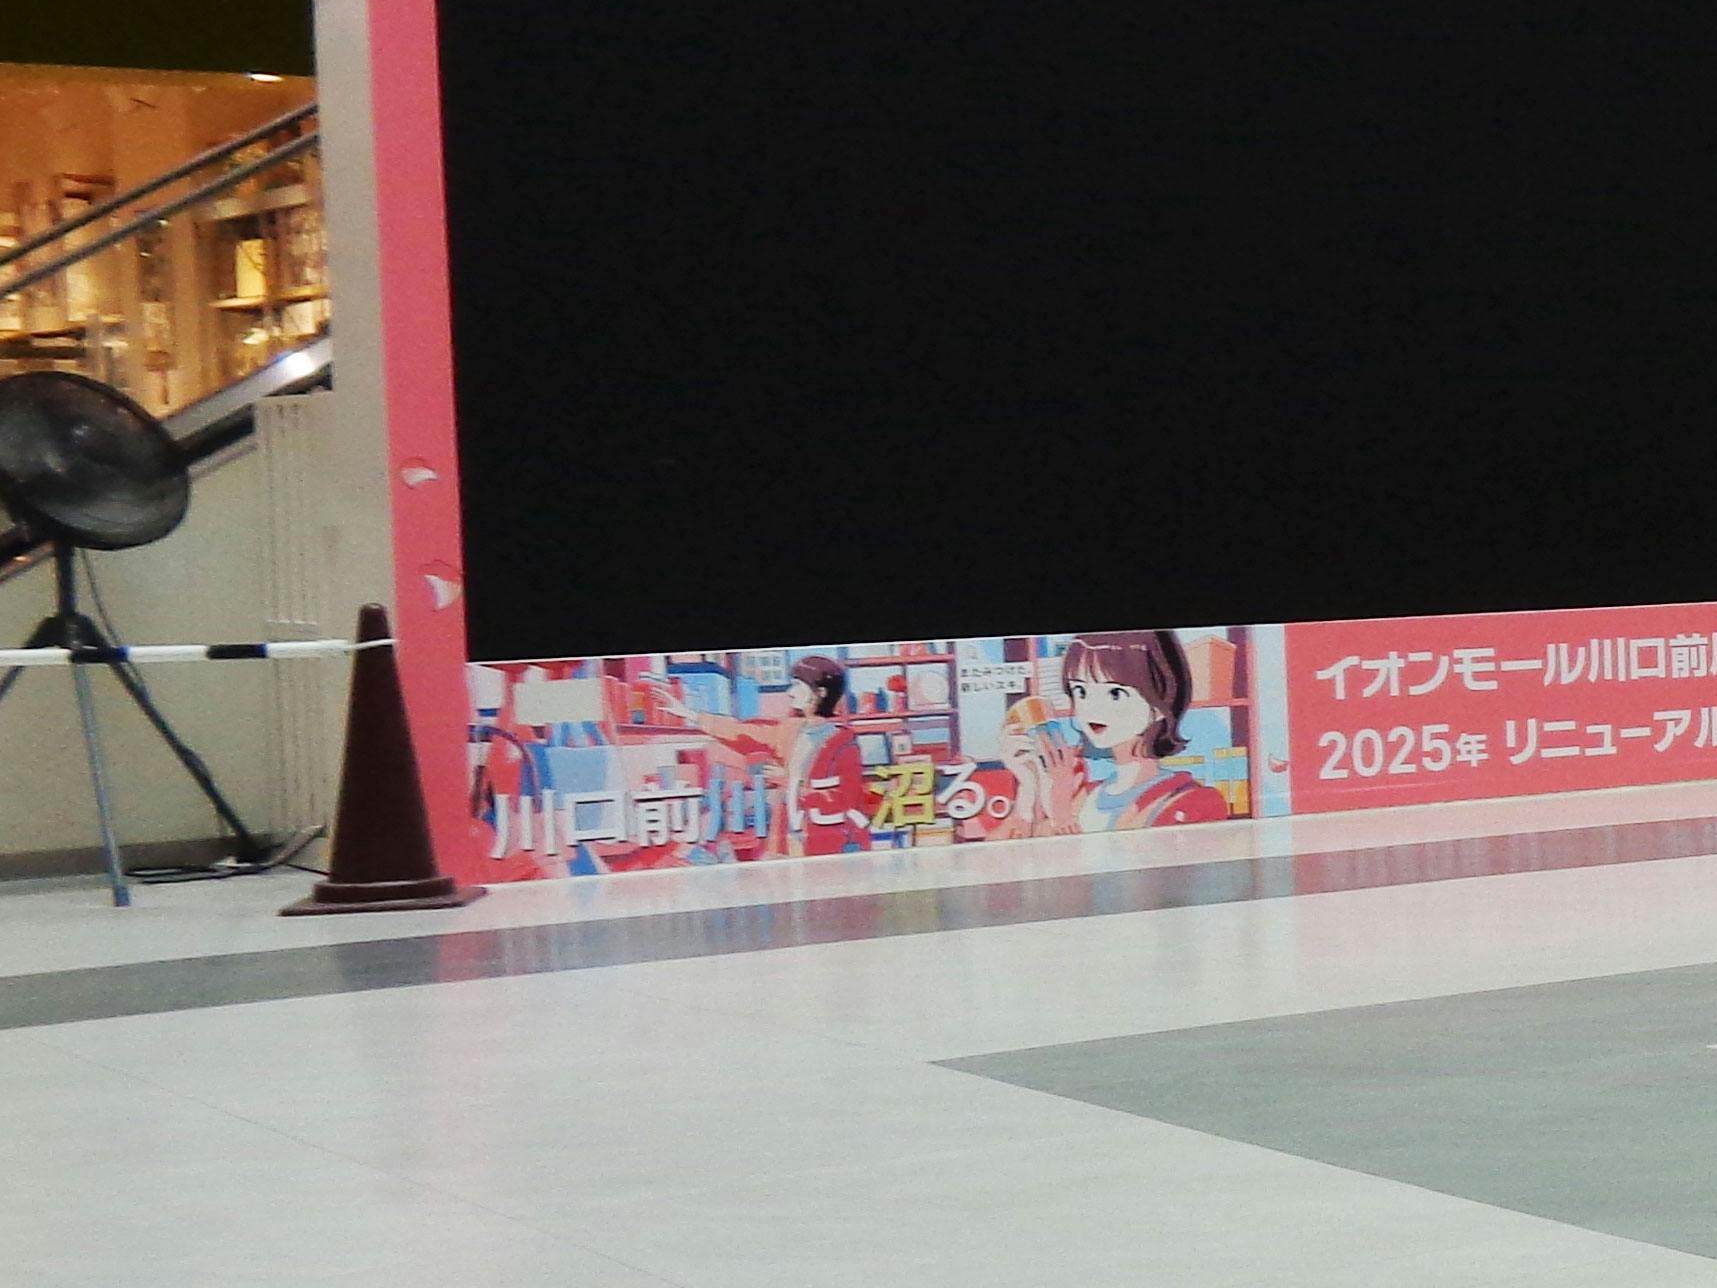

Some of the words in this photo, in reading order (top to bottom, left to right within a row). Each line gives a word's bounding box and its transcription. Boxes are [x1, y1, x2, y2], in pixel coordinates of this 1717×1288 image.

[1317, 723, 1489, 781] 2025年
[489, 761, 1014, 860] 川口前川に、沼る。
